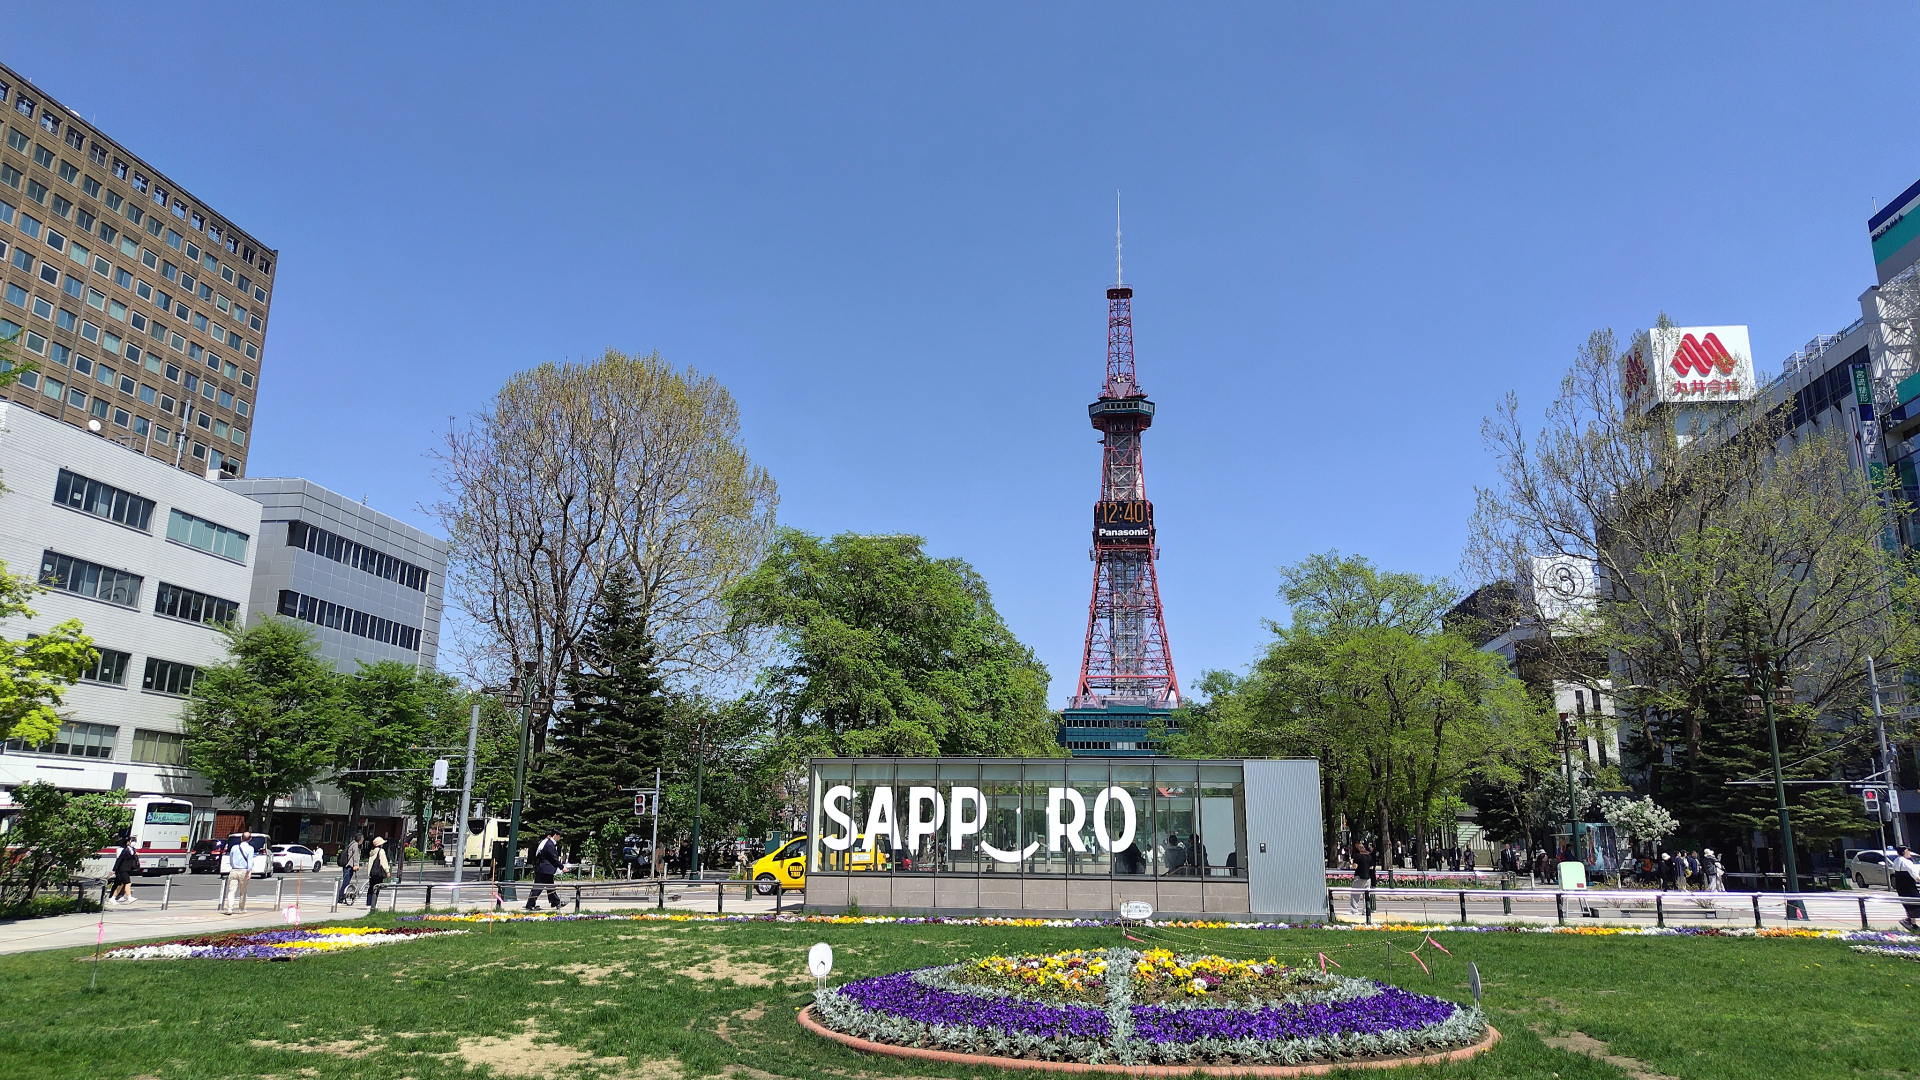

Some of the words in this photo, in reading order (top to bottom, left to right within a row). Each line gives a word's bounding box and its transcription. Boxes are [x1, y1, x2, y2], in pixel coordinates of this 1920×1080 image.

[1672, 379, 1739, 395] 丸井今井
[1103, 502, 1144, 523] 12:40
[1099, 528, 1148, 537] Panasonic
